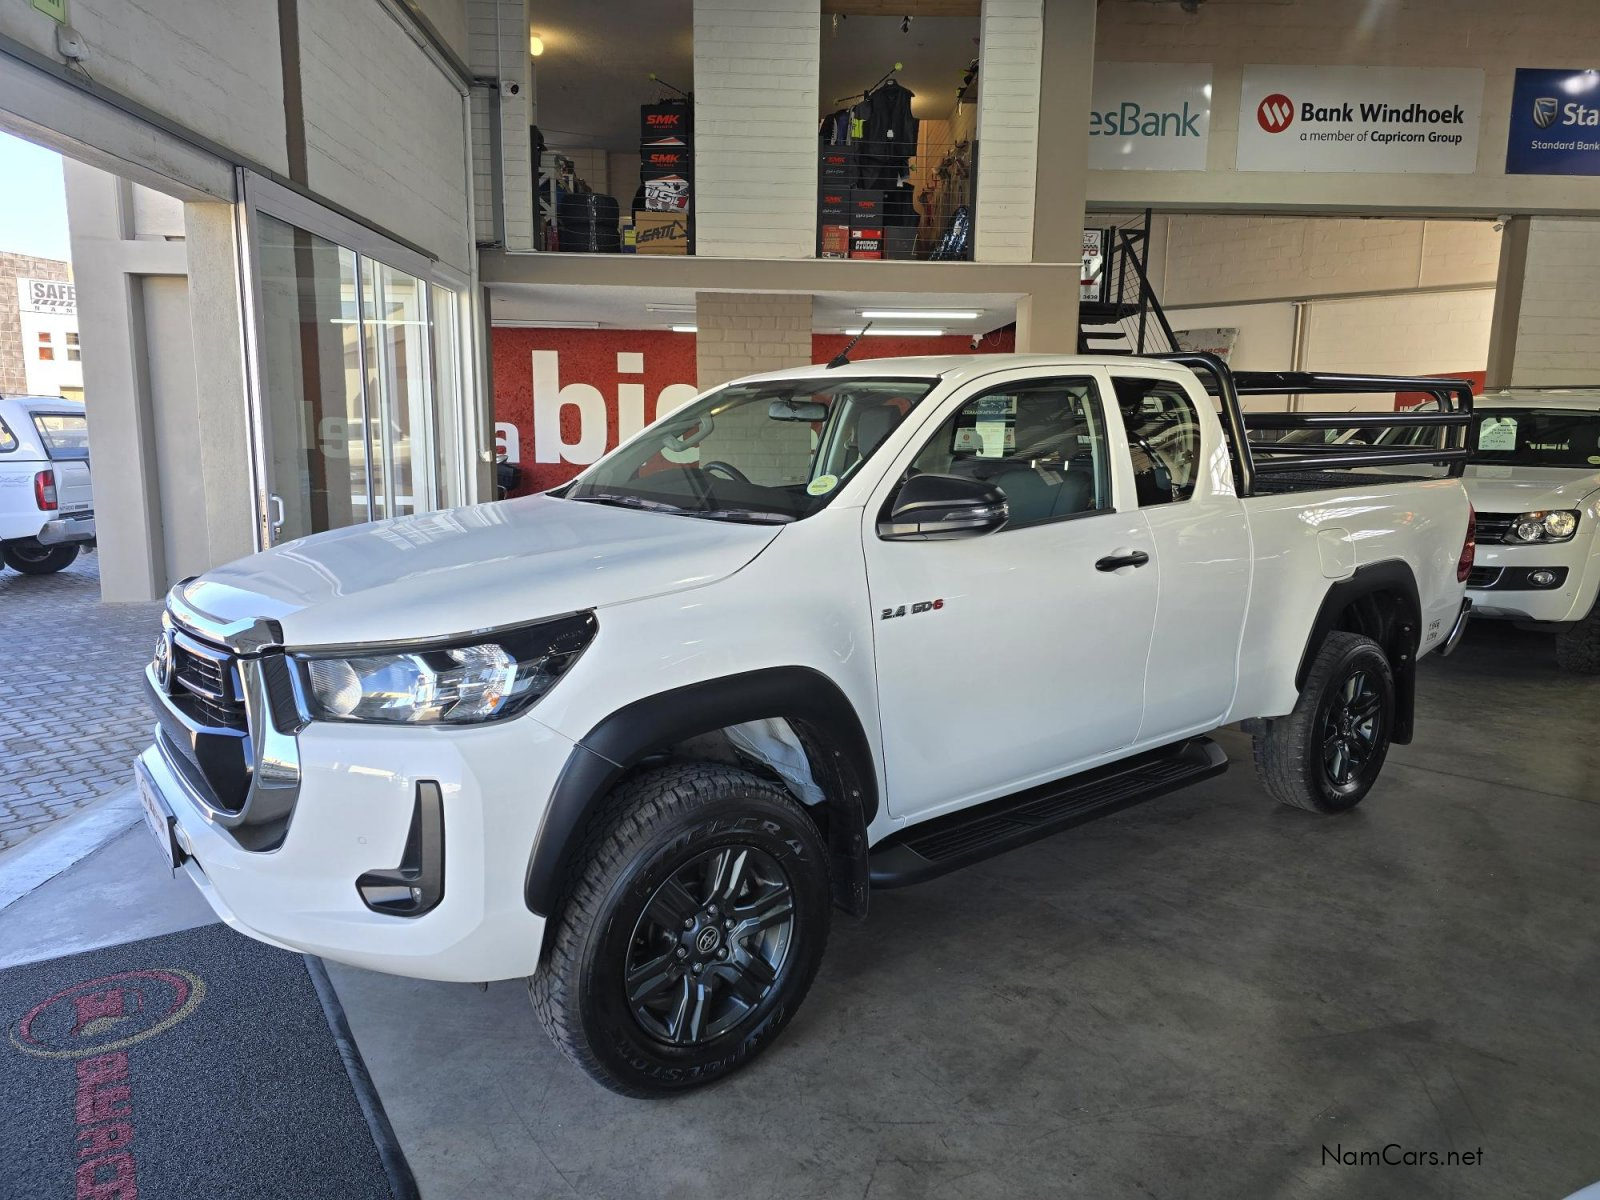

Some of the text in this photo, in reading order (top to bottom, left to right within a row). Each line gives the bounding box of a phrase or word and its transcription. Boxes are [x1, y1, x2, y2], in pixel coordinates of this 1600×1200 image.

[646, 115, 680, 125] SMK
[1301, 103, 1464, 124] Bank Windhoek
[1562, 103, 1599, 126] Sta
[1300, 131, 1462, 146] a member of Capricorn Group
[1531, 141, 1600, 151] Standard Bank
[649, 154, 680, 163] SMK
[34, 283, 76, 300] SAFE
[881, 605, 906, 620] 2.4
